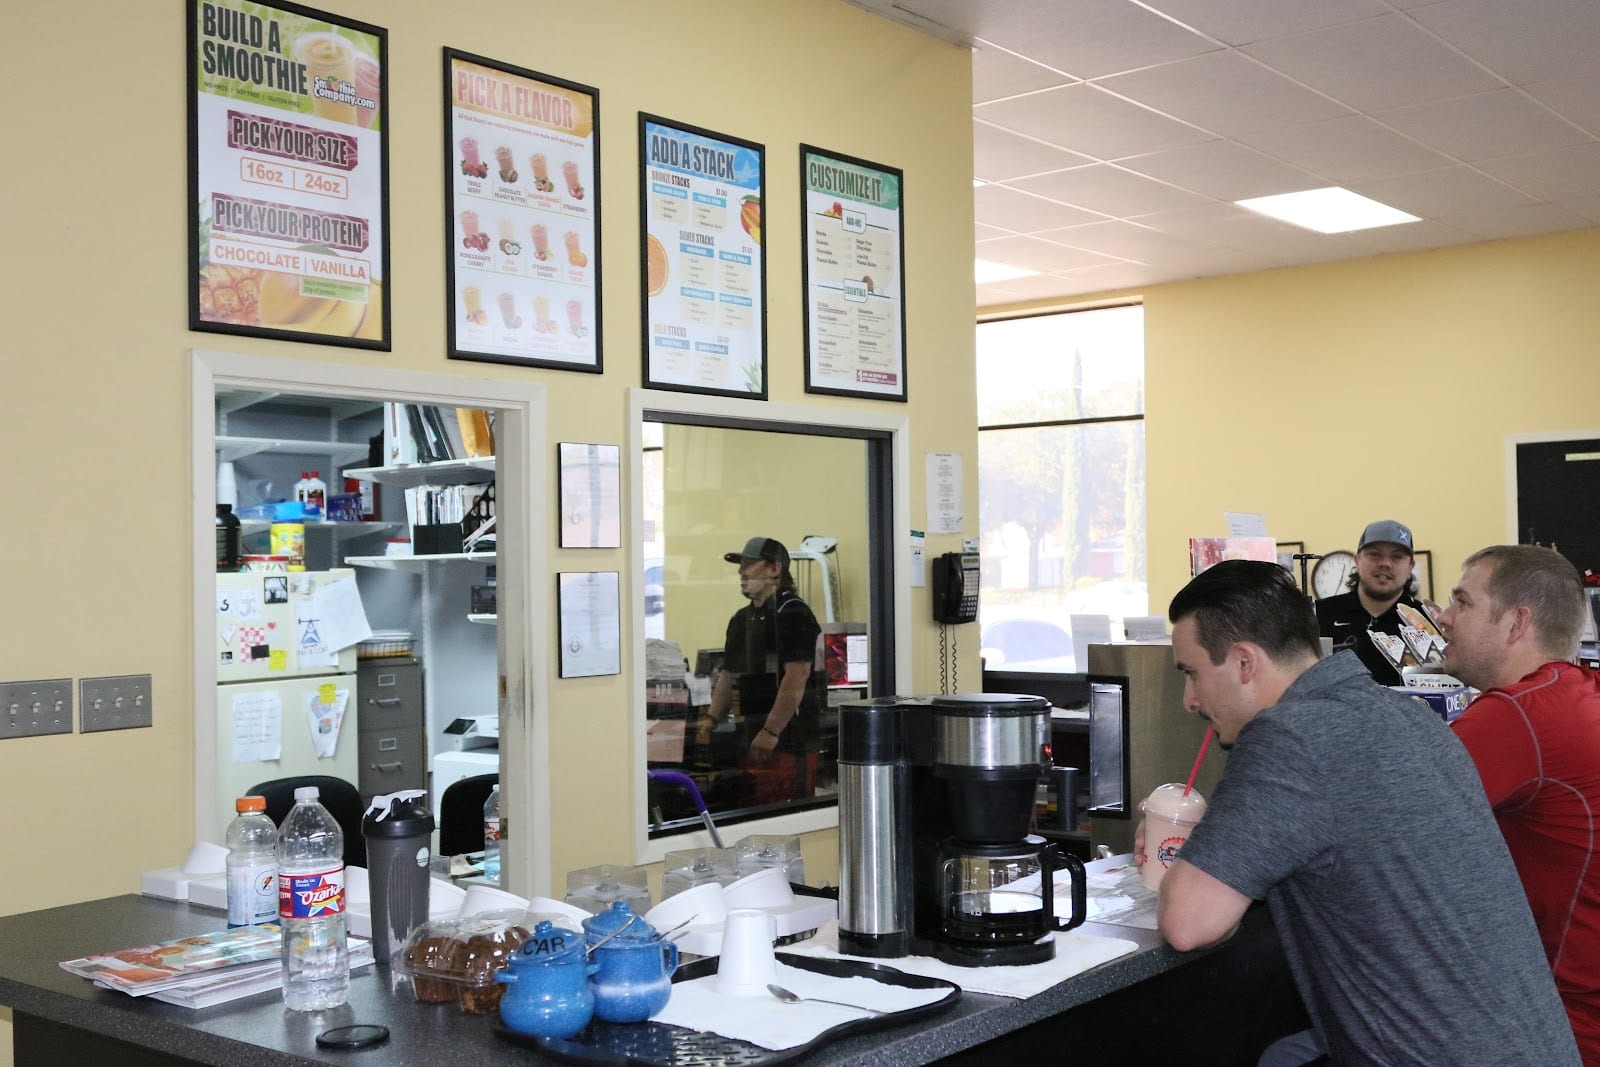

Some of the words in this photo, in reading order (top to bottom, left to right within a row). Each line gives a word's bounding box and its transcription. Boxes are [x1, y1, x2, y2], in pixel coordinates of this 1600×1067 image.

[203, 3, 262, 48] BUILD
[268, 20, 281, 54] A
[203, 40, 308, 96] SMOOTHIE
[314, 88, 375, 110] Company.com
[457, 71, 498, 110] PICK
[502, 84, 512, 114] A
[516, 86, 573, 128] FLAVOR
[234, 118, 270, 149] PICK
[274, 126, 314, 158] YOUR
[318, 135, 348, 165] SIZE
[652, 134, 679, 166] ADD
[682, 142, 690, 170] A
[693, 145, 734, 180] STACK
[247, 162, 283, 183] 16oz
[305, 173, 340, 193] 24oz
[671, 175, 690, 188] STACKS
[810, 162, 870, 199] CUSTOMIZE
[872, 178, 882, 202] IT
[563, 203, 587, 213] STRAWBERRY
[215, 200, 253, 230] PICK
[256, 206, 298, 236] YOUR
[302, 214, 362, 248] PROTEIN
[696, 234, 714, 246] STACKS
[214, 244, 299, 269] CHOCOLATE
[311, 258, 366, 279] VANILLA
[845, 286, 866, 297] ESSENTIALS
[668, 325, 687, 337] STACKS
[1446, 695, 1460, 712] ONE
[523, 936, 566, 956] CAR
